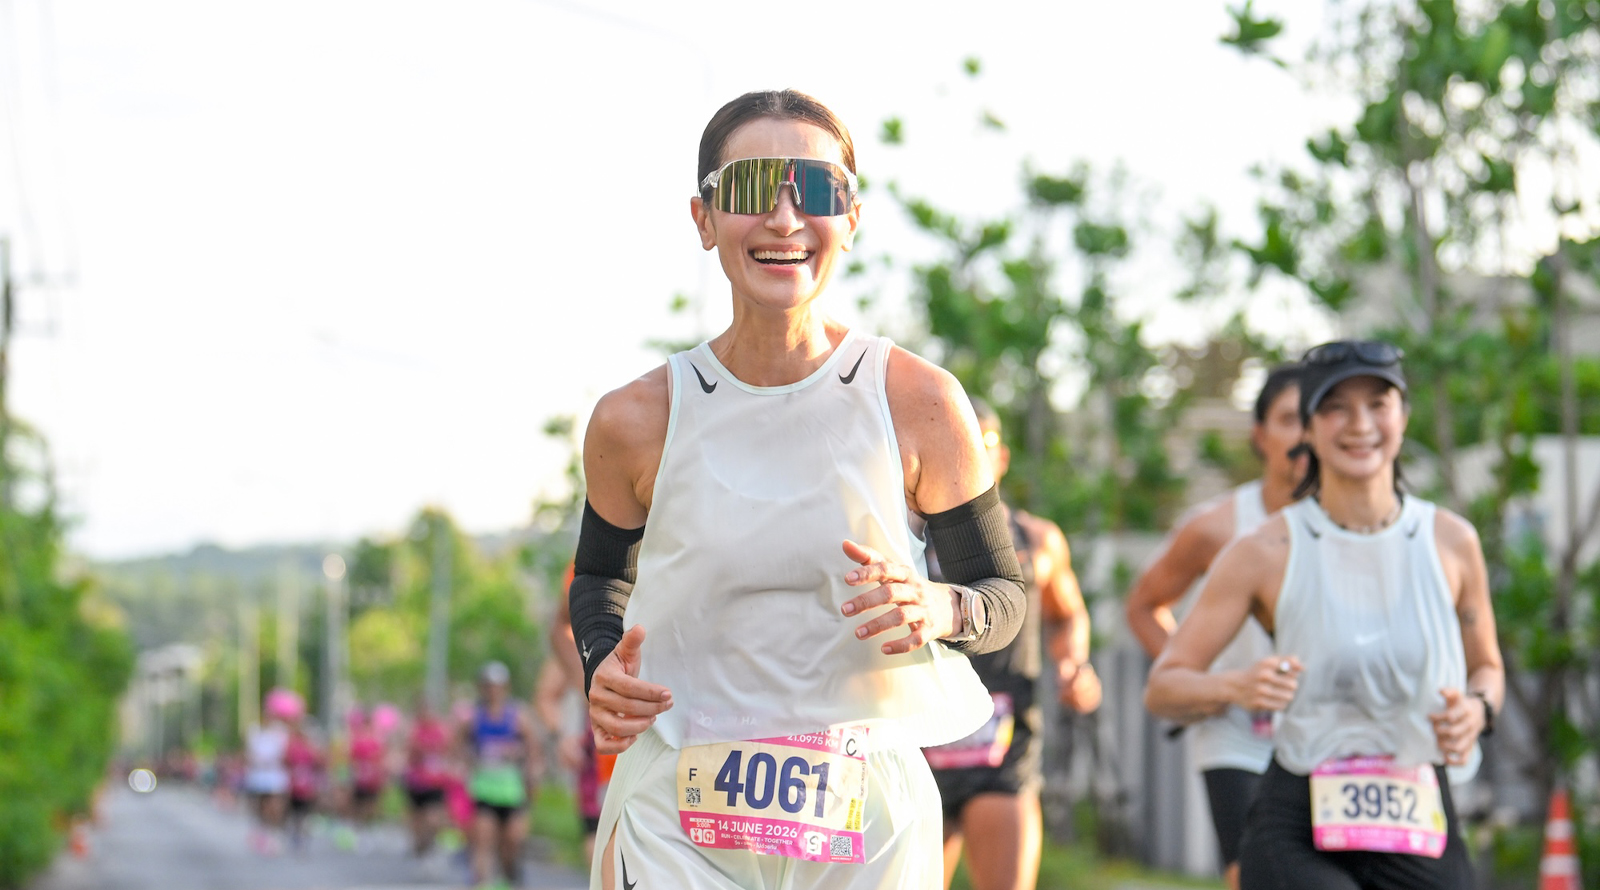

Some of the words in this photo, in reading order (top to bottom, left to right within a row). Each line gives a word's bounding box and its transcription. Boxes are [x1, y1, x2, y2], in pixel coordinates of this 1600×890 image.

[787, 734, 823, 746] 21.0975
[845, 738, 857, 756] C
[689, 768, 698, 781] F
[714, 750, 830, 818] 4061
[1341, 782, 1419, 823] 3952
[717, 820, 729, 832] 14
[730, 821, 763, 834] JUNE
[765, 825, 798, 838] 2026
[764, 837, 793, 845] TOGETHER
